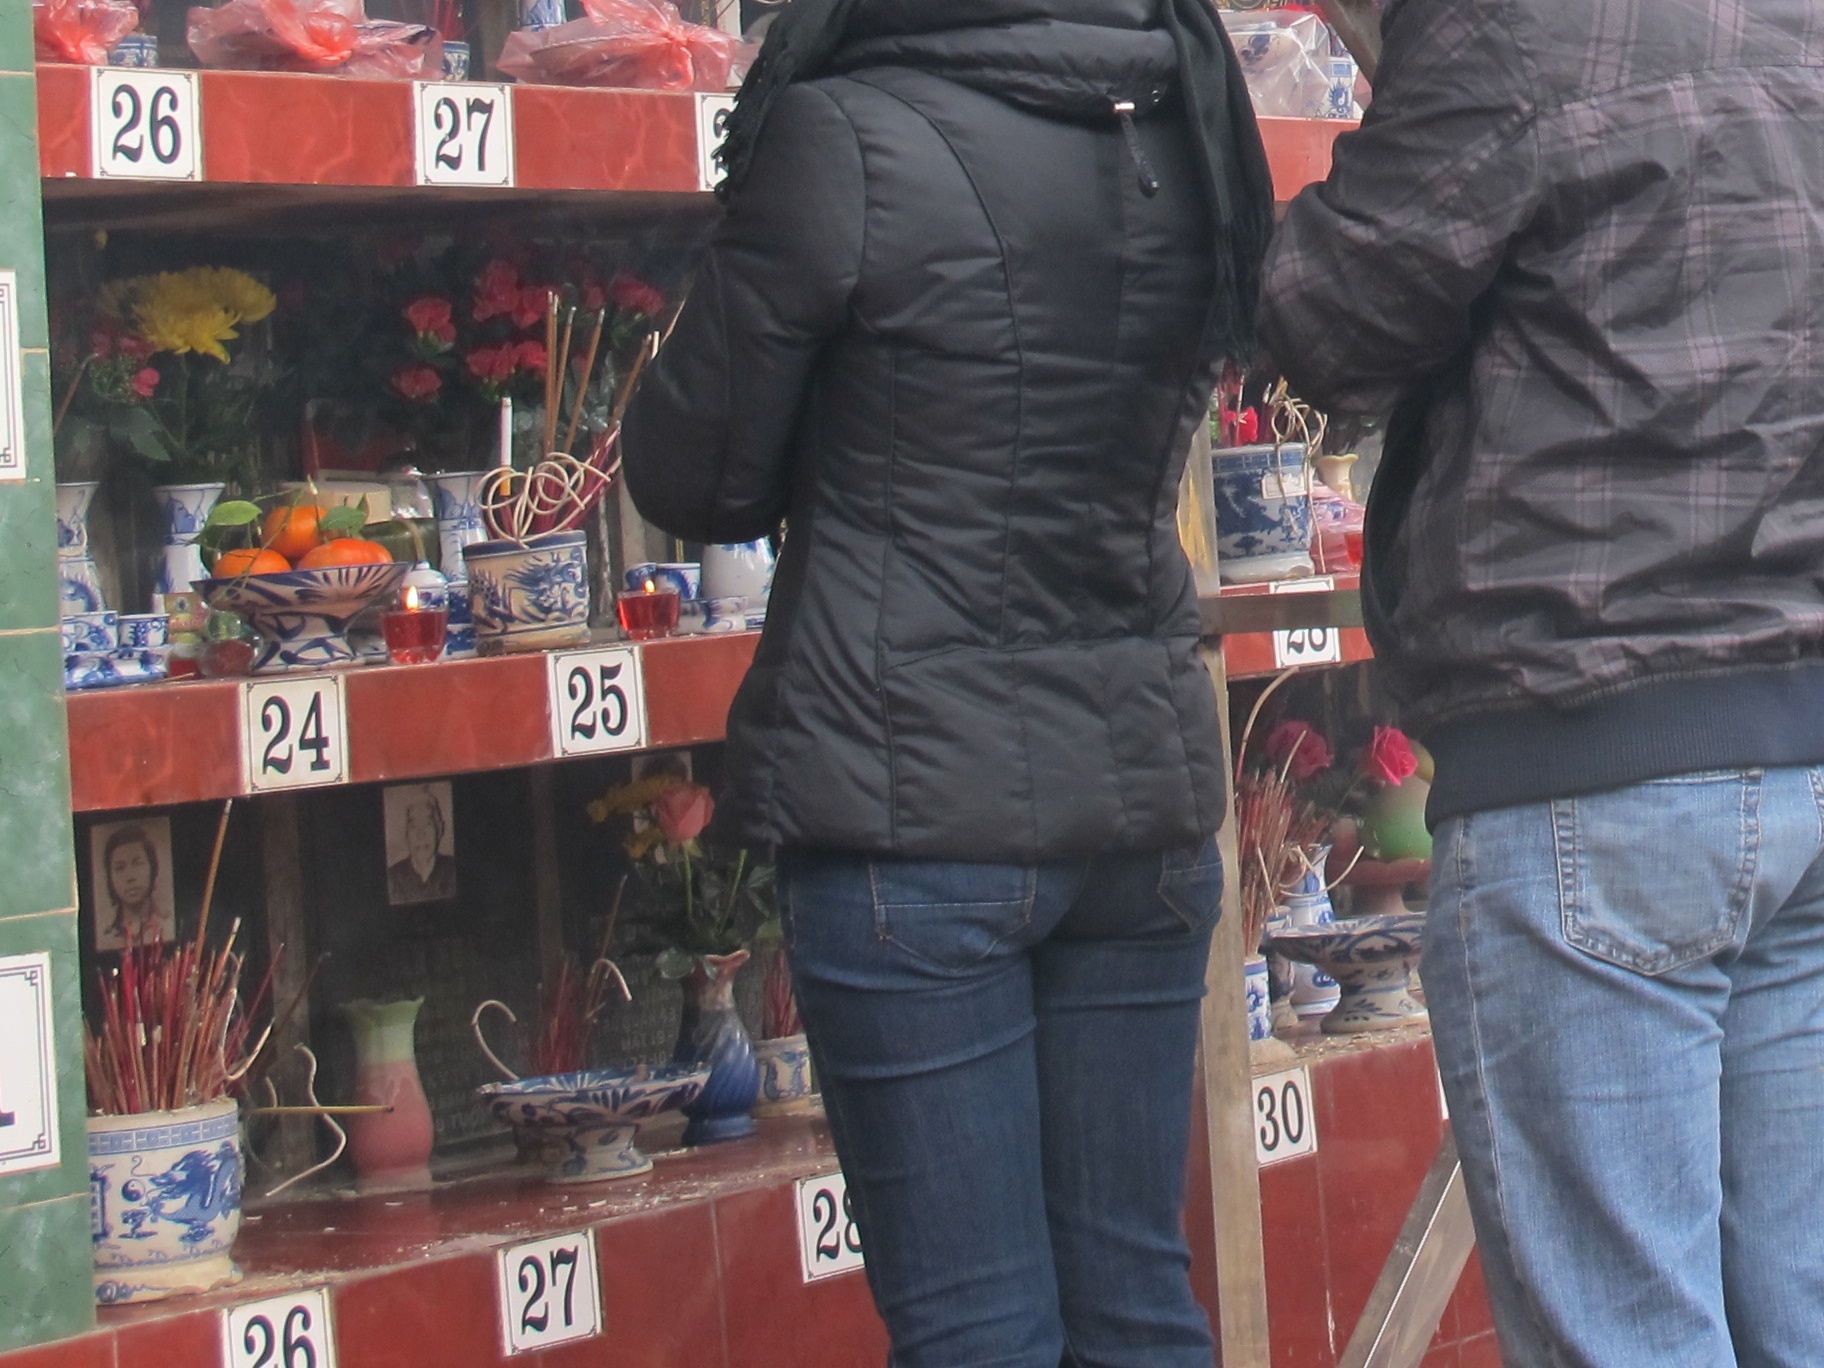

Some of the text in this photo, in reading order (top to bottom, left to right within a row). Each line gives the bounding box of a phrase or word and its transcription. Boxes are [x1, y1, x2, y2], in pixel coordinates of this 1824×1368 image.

[112, 84, 181, 164] 26
[434, 97, 494, 171] 27
[262, 692, 330, 774] 24
[568, 664, 628, 740] 25
[1258, 1080, 1303, 1151] 30
[518, 1247, 578, 1334] 27
[245, 1305, 311, 1368] 26
